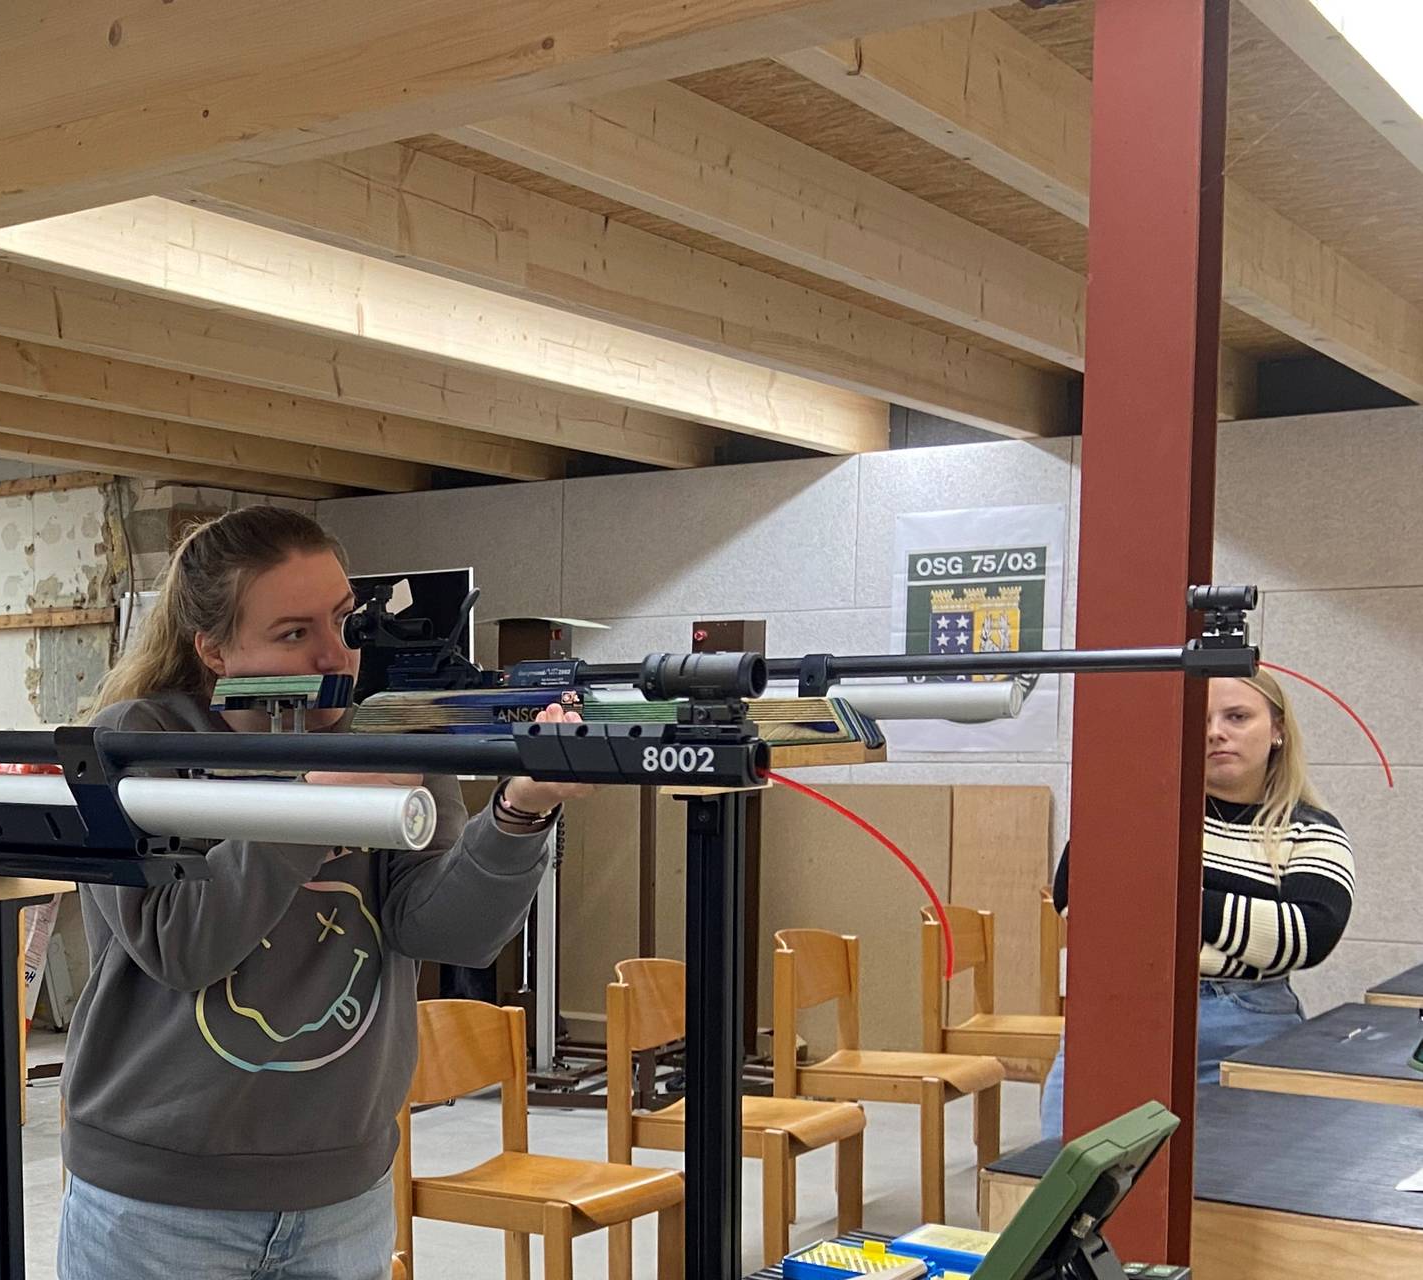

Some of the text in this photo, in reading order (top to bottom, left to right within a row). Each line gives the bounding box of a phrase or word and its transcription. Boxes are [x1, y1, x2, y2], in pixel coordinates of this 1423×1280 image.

[916, 552, 1037, 576] OSG 75/03
[498, 707, 543, 723] ANSC
[642, 746, 715, 772] 8002
